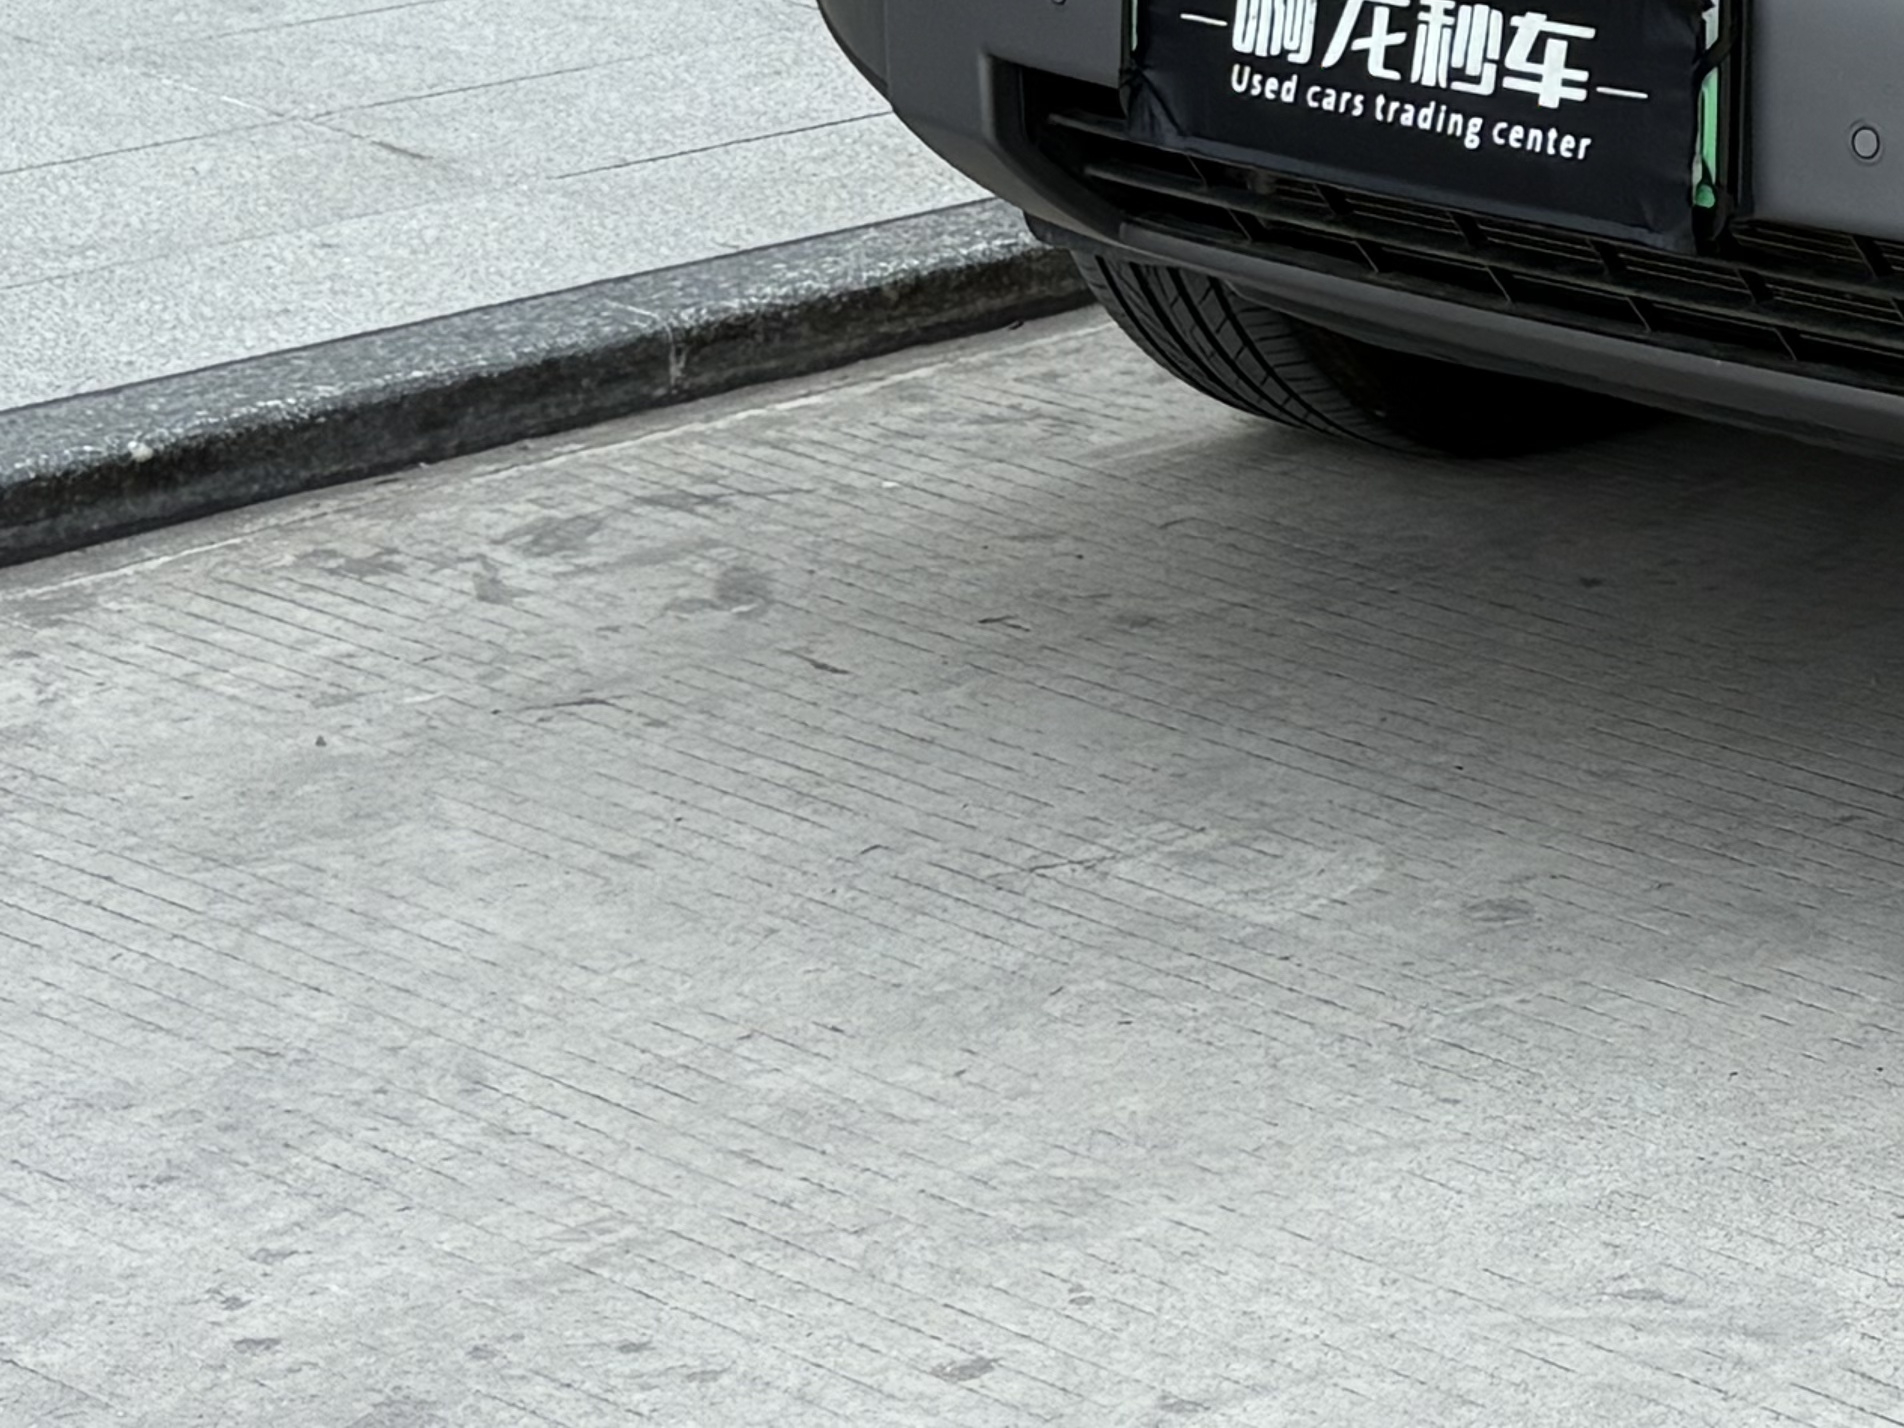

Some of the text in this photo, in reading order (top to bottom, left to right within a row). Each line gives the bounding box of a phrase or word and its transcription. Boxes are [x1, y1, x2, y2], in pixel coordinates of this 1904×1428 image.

[1231, 63, 1592, 161] Used cars trading center
